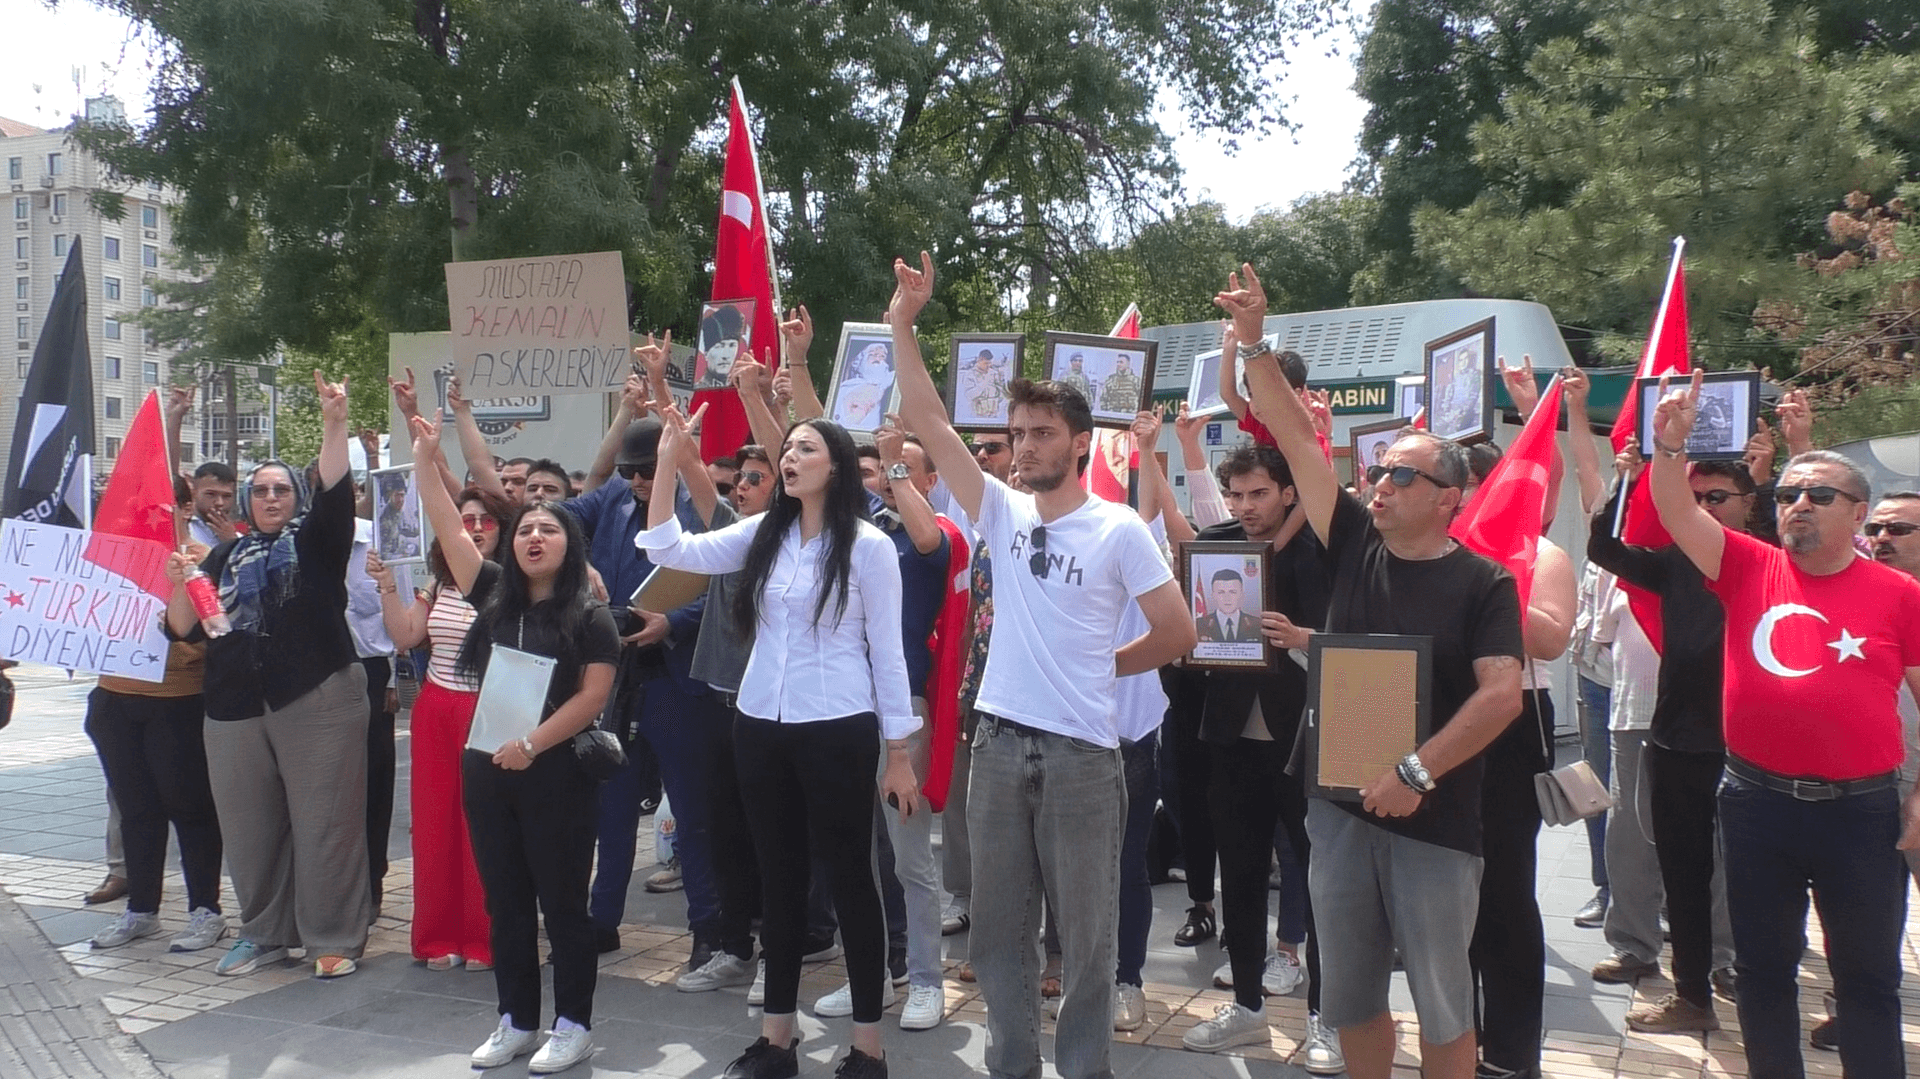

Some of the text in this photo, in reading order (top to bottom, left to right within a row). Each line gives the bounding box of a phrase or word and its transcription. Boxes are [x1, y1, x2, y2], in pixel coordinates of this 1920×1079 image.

[476, 259, 583, 299] MUSTAFA
[469, 344, 627, 388] ASKERLERİYİZ
[5, 527, 38, 567] NE
[27, 577, 152, 644] TÜRKÜM
[9, 623, 121, 673] DİYENE
